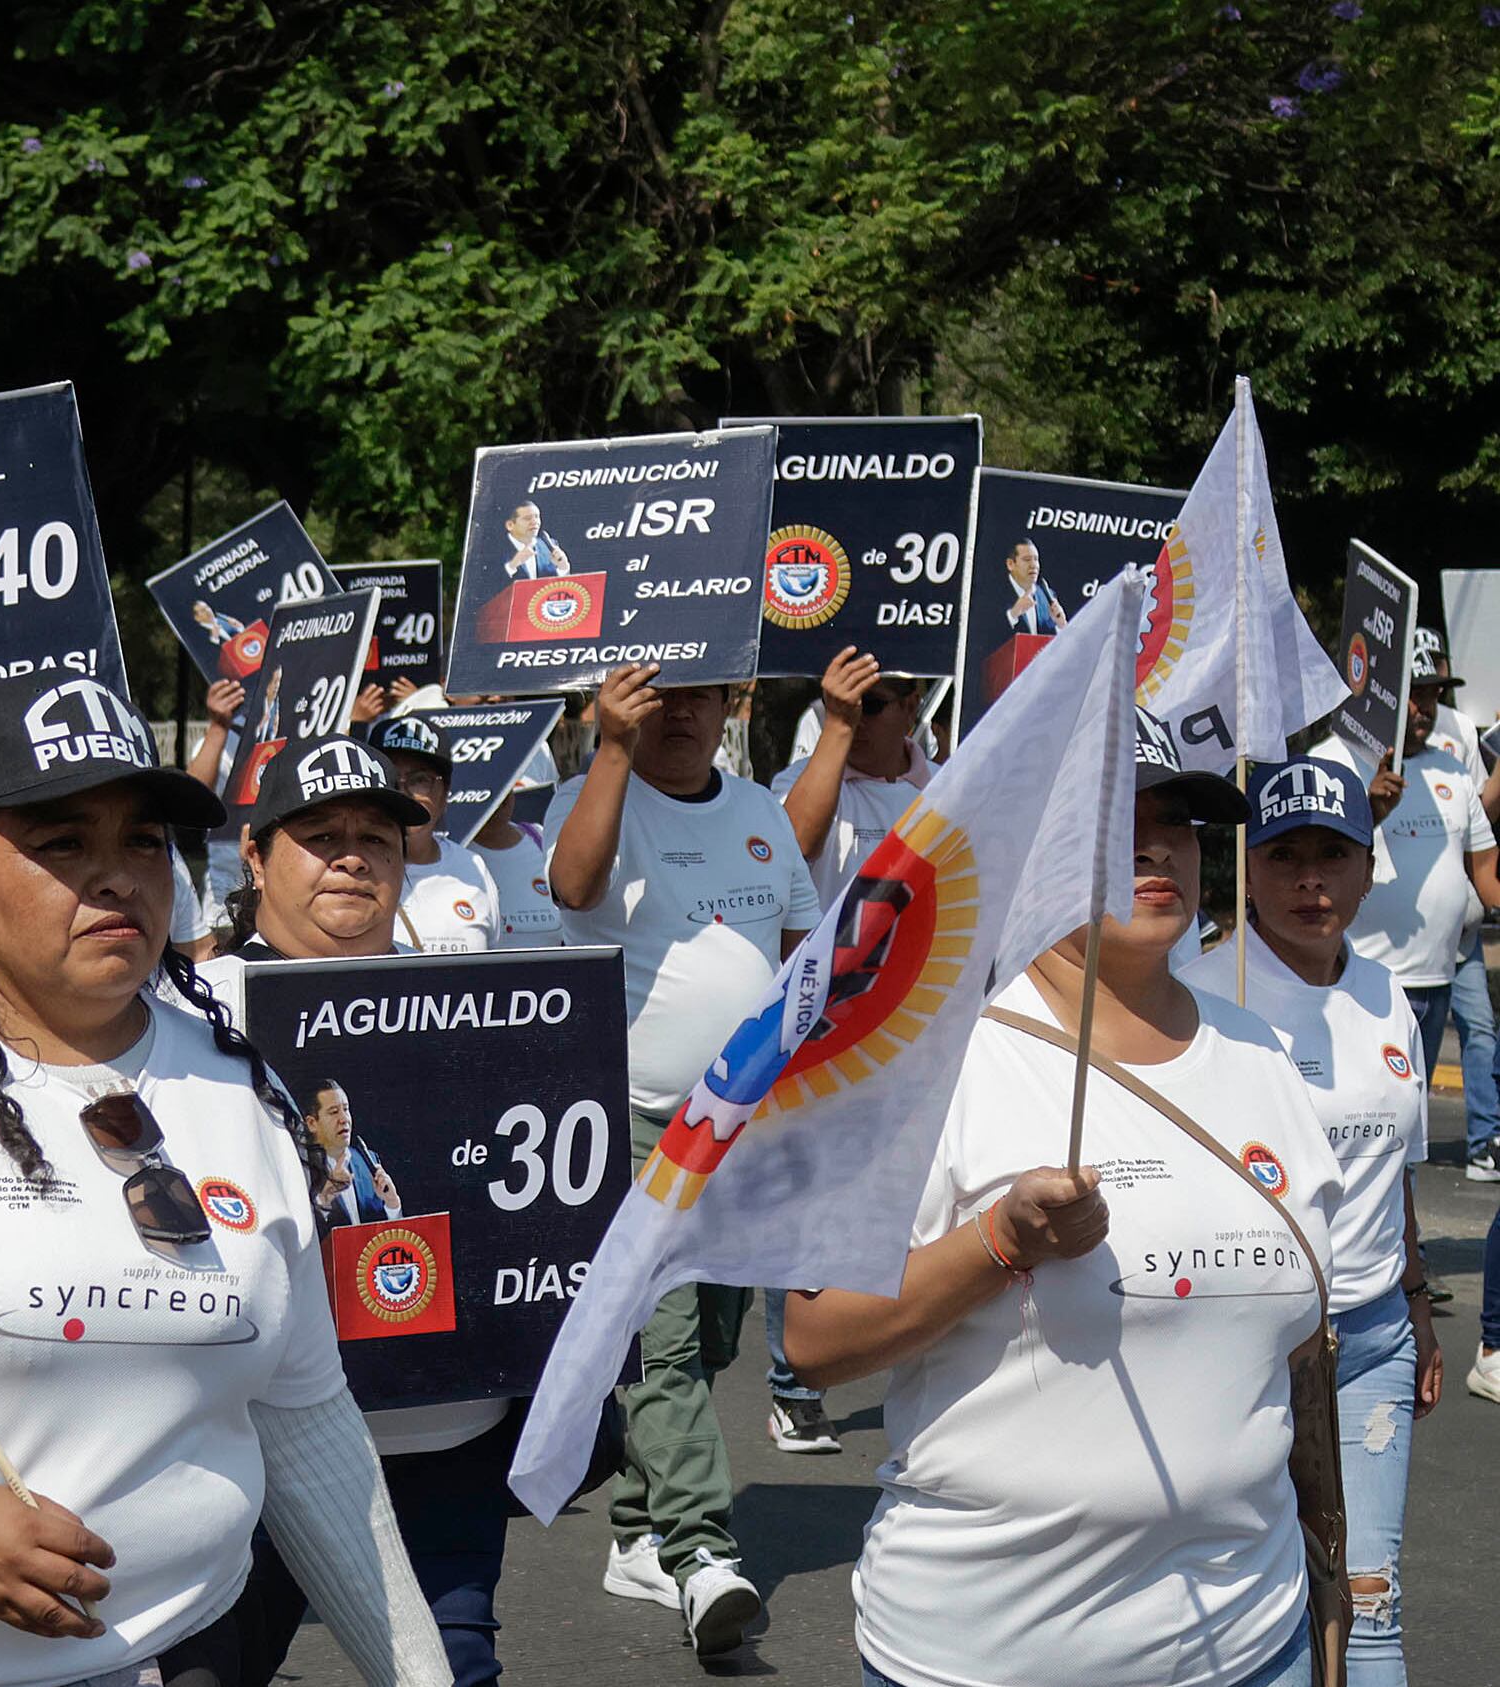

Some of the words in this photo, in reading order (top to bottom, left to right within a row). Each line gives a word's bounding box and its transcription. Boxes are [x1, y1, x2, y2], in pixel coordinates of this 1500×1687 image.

[528, 459, 719, 493] ¡DISMINUCIÓN!
[586, 522, 624, 540] del
[625, 498, 716, 538] ISR
[1026, 506, 1176, 541] ¡DISMINUCIÓ
[195, 537, 260, 586] ¡JORNADA
[208, 550, 269, 593] LABORAL
[625, 555, 649, 572] al
[862, 549, 887, 566] de
[890, 532, 960, 584] 30
[279, 561, 325, 600] 40
[380, 588, 408, 600] ORAL
[635, 577, 752, 599] SALARIO
[277, 611, 354, 648] ¡AGUINALDO
[394, 612, 435, 645] 40
[619, 608, 638, 626] y
[877, 600, 953, 626] DÍAS!
[1373, 607, 1395, 649] ISR
[382, 654, 428, 667] HORAS!
[497, 642, 708, 668] PRESTACIONES!
[24, 679, 152, 755] CTM
[298, 675, 347, 739] 30
[430, 710, 533, 728] DISMINUCIÓN!
[384, 717, 440, 750] CTM
[297, 741, 387, 786] CTM
[1259, 763, 1345, 810] CTM
[1261, 796, 1345, 826] PUEBLA
[698, 892, 775, 913] syncreon
[501, 913, 556, 926] yncreon
[796, 958, 820, 1035] MÉXICO
[296, 988, 572, 1048] ¡AGUINALDO
[1324, 1123, 1396, 1140] ncreon
[452, 1139, 488, 1166] de
[488, 1100, 609, 1211] 30
[11, 1185, 22, 1193] de
[122, 1266, 161, 1280] supply
[166, 1266, 197, 1280] chain
[200, 1270, 241, 1287] synergy
[1145, 1246, 1301, 1277] syncreon
[494, 1257, 592, 1306] DÍAS
[29, 1286, 241, 1318] syncreon
